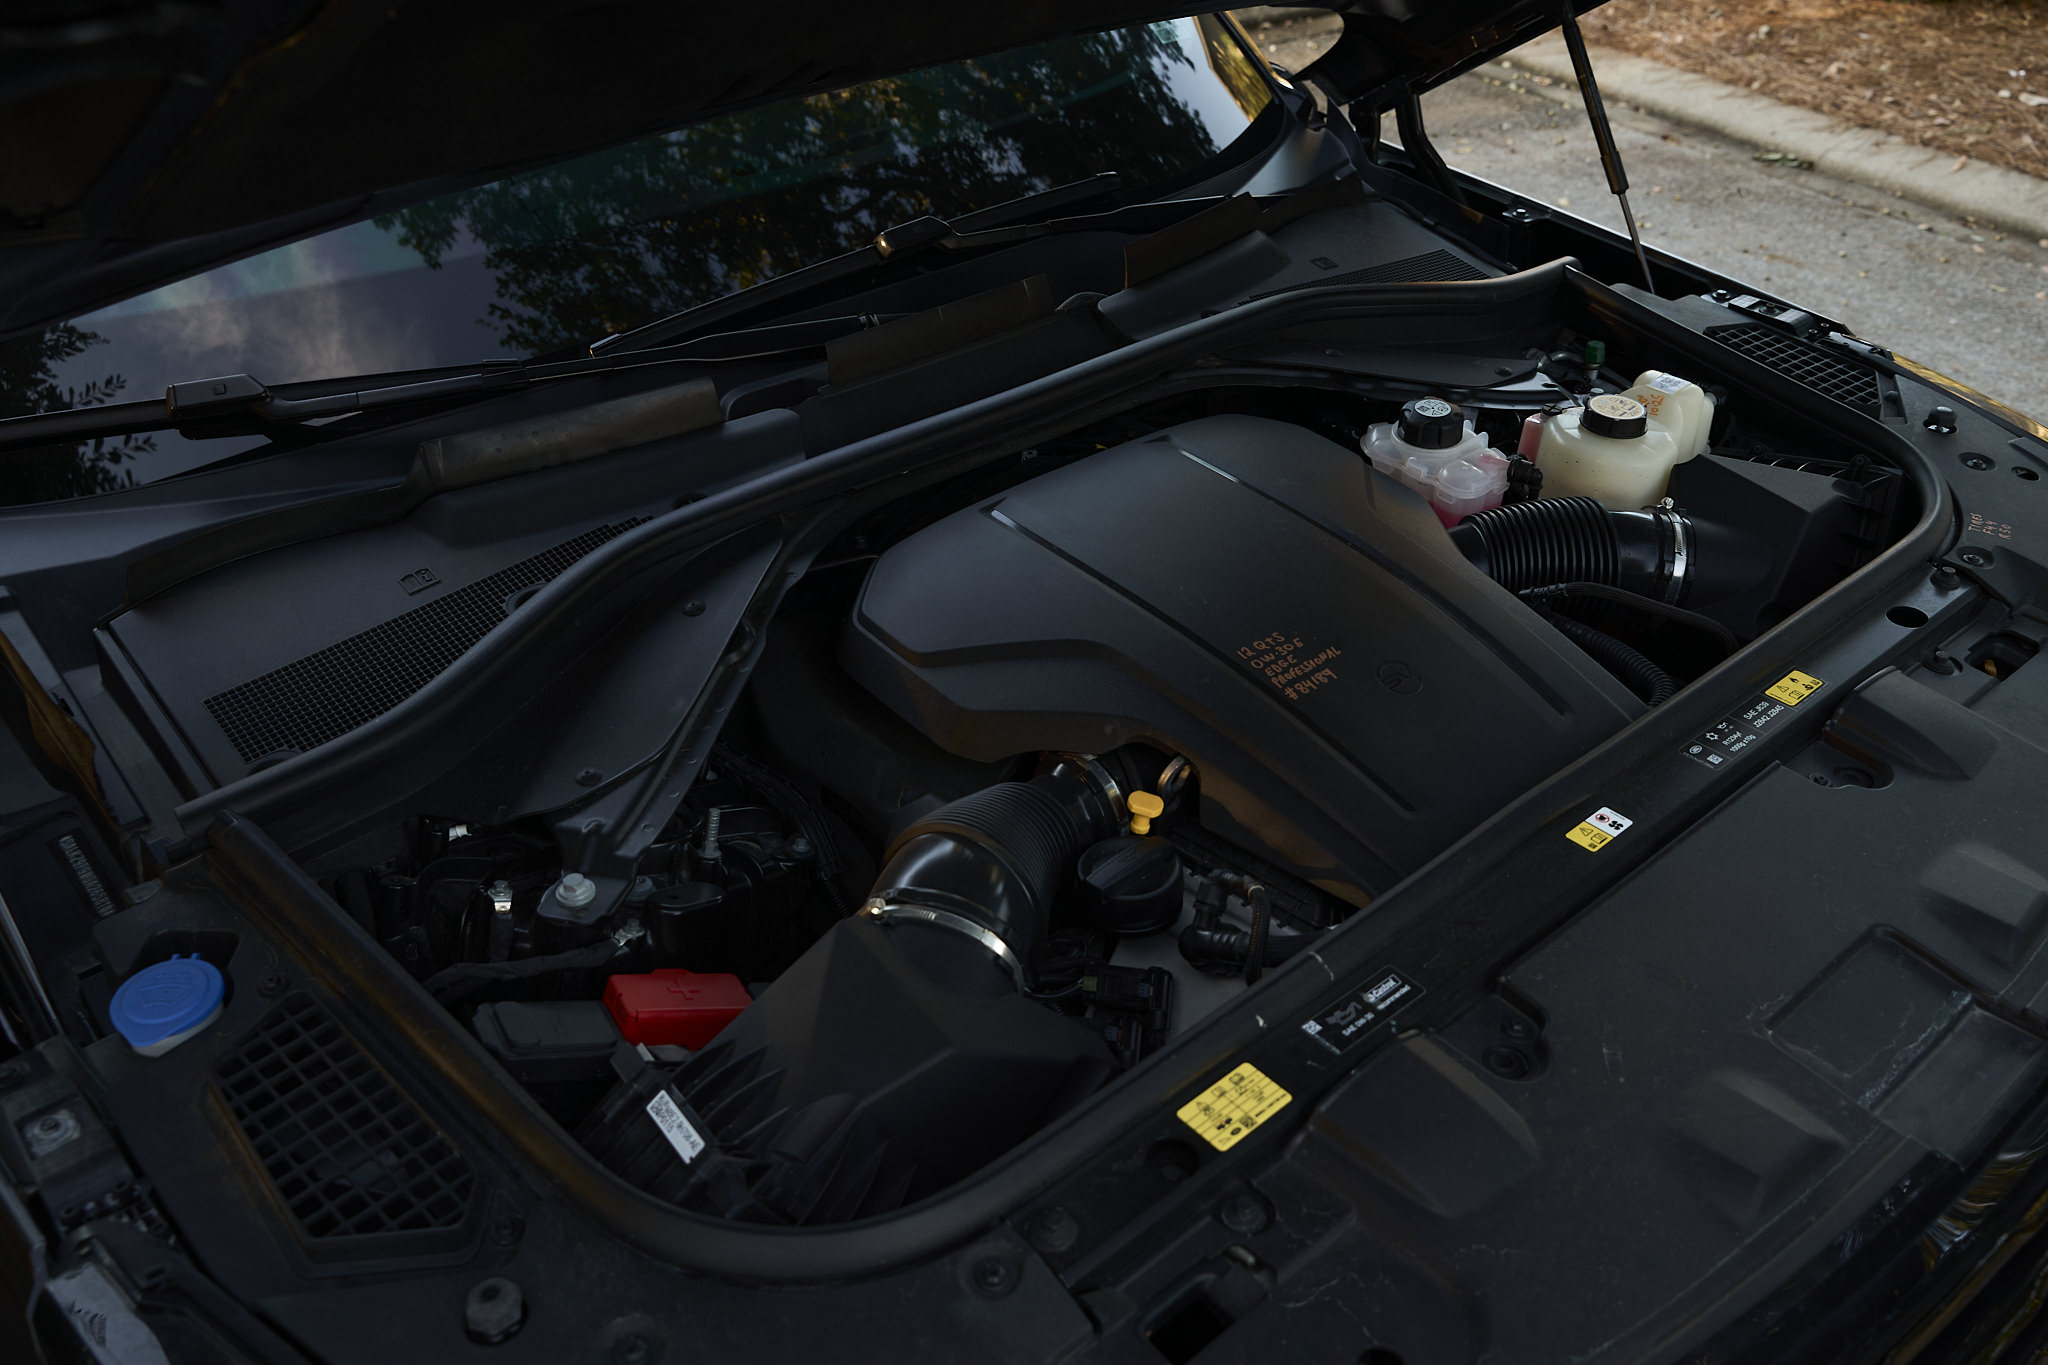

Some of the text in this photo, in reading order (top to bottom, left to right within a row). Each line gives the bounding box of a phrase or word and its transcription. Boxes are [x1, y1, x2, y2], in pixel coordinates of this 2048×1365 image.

[1236, 647, 1256, 660] 12
[1263, 654, 1299, 677] EDGE
[1270, 645, 1343, 689] PROFESSIONAL
[1283, 668, 1339, 701] #84189
